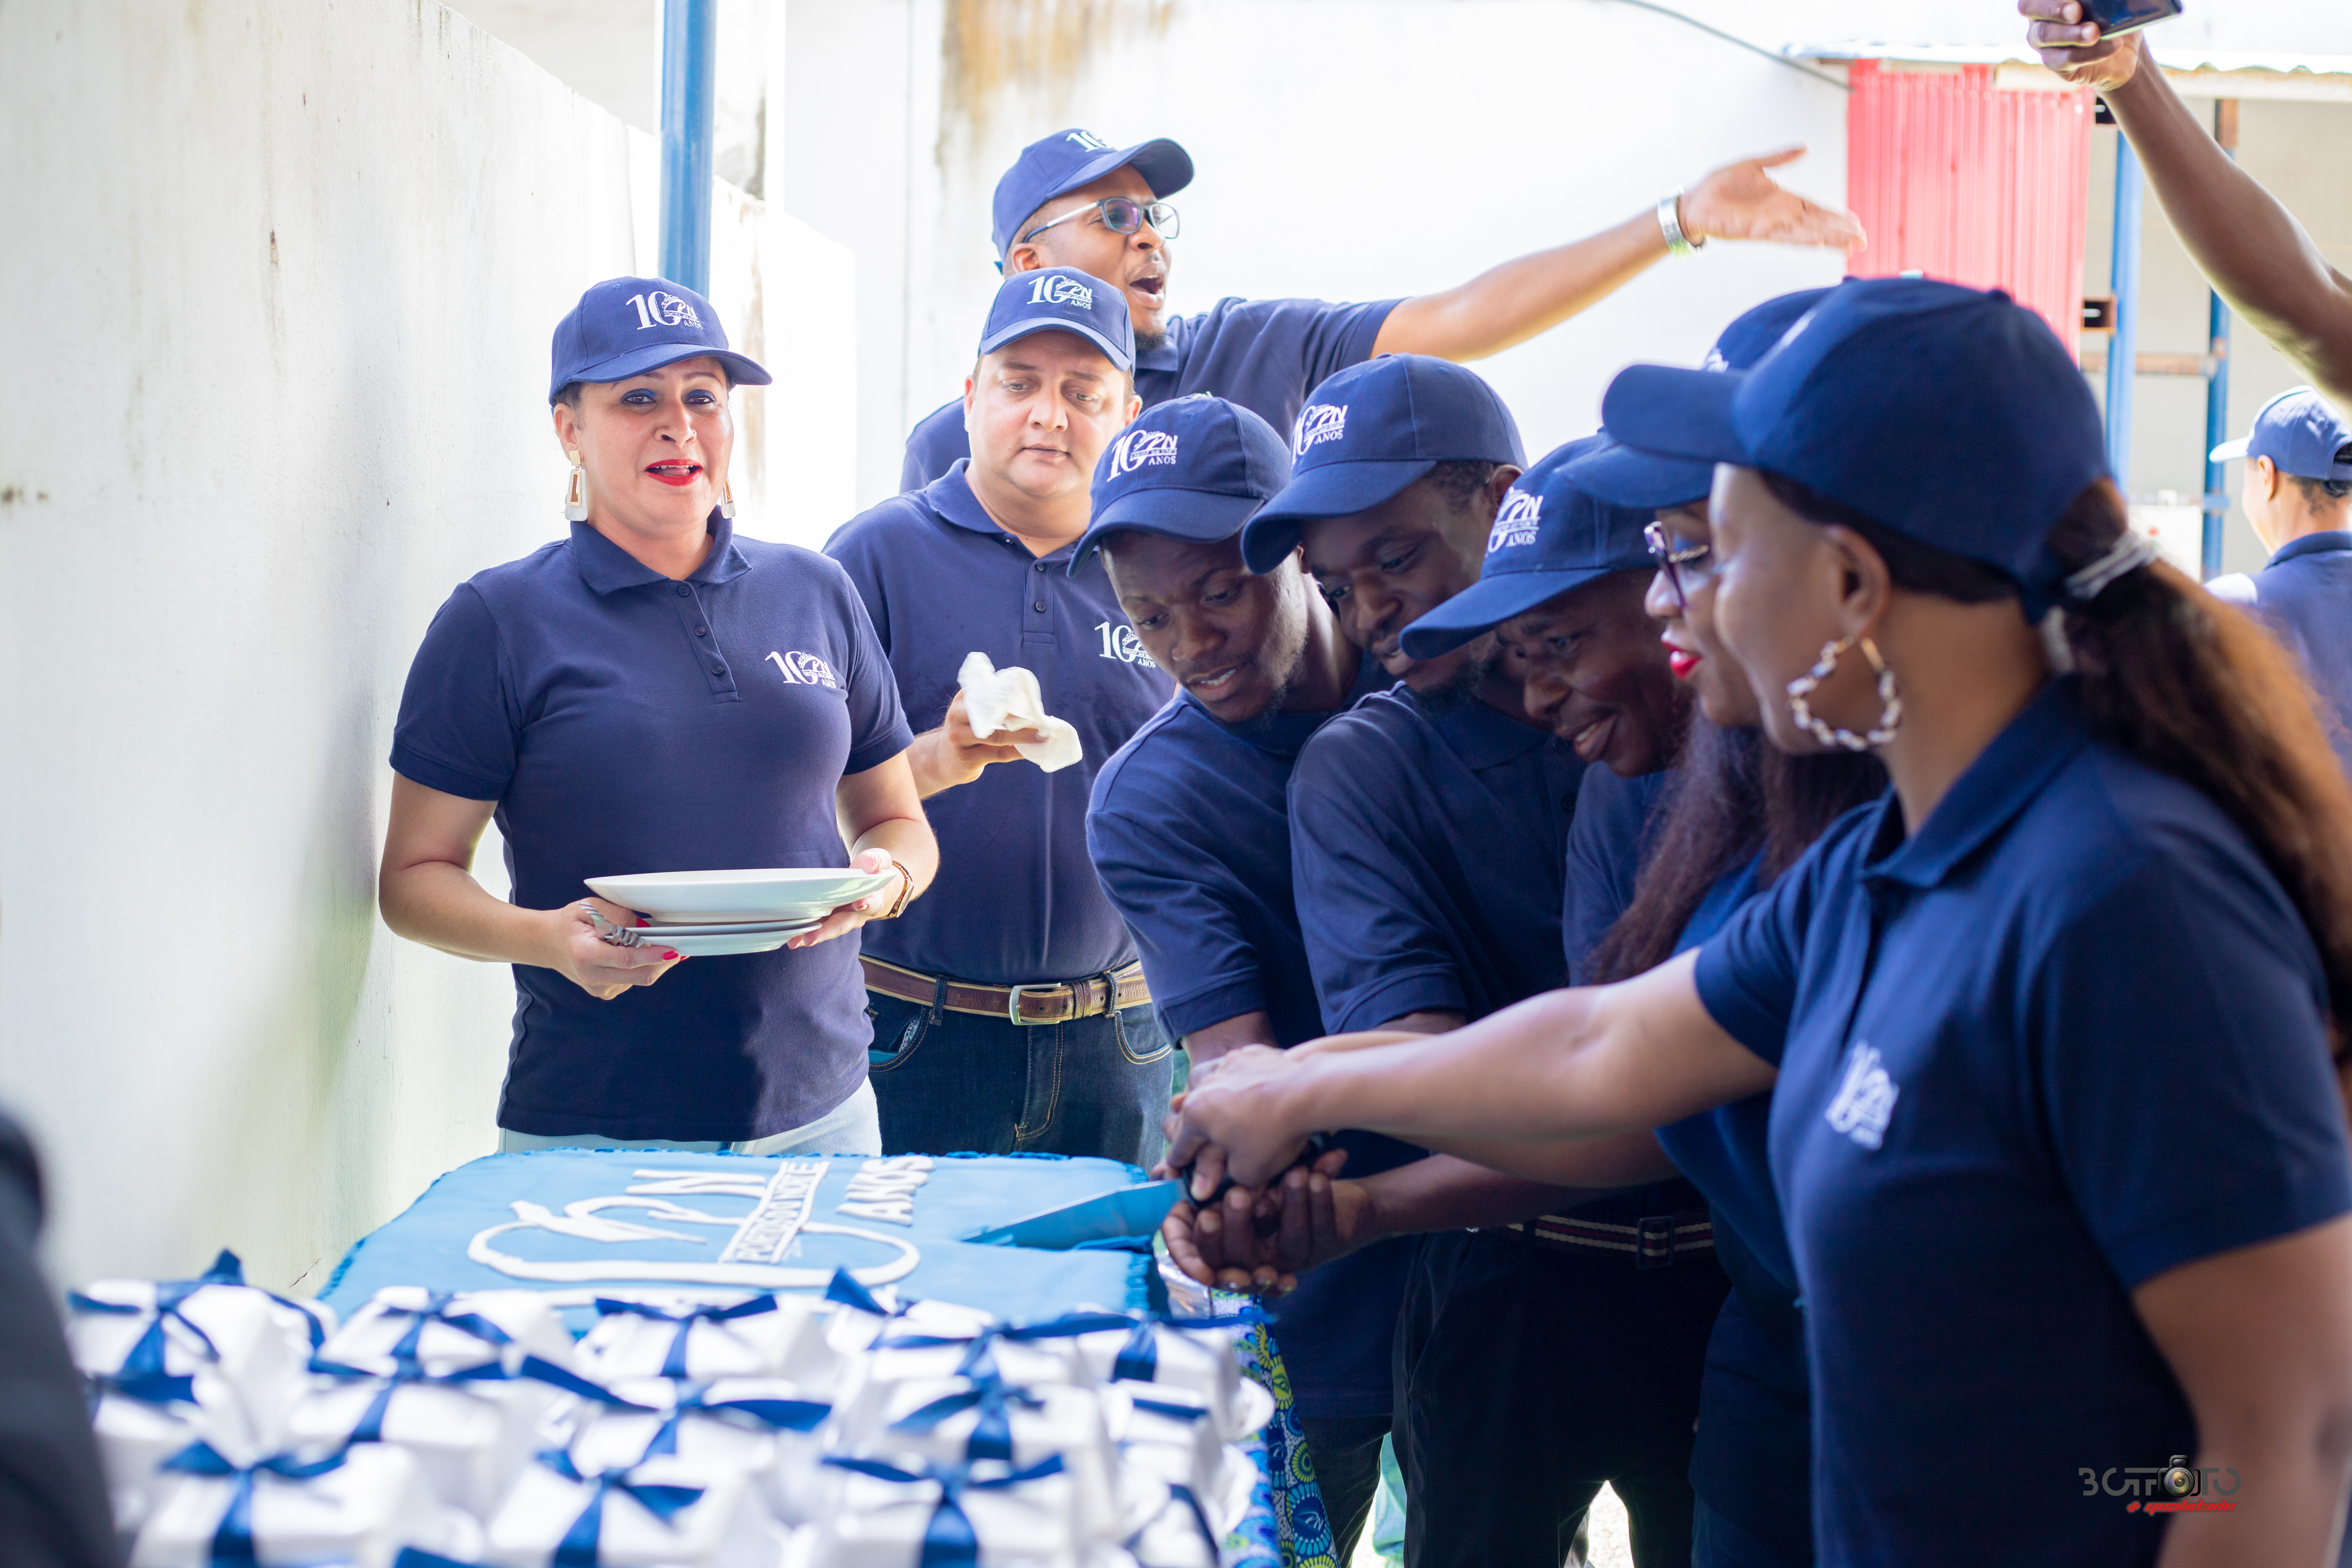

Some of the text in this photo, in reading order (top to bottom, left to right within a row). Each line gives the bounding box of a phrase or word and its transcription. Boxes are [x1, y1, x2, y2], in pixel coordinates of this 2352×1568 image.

[1071, 300, 1092, 310] ANOS
[1314, 429, 1343, 445] ANOS
[1148, 455, 1176, 466] ANOS
[1138, 658, 1156, 668] ANOS
[836, 1155, 934, 1227] ANOS
